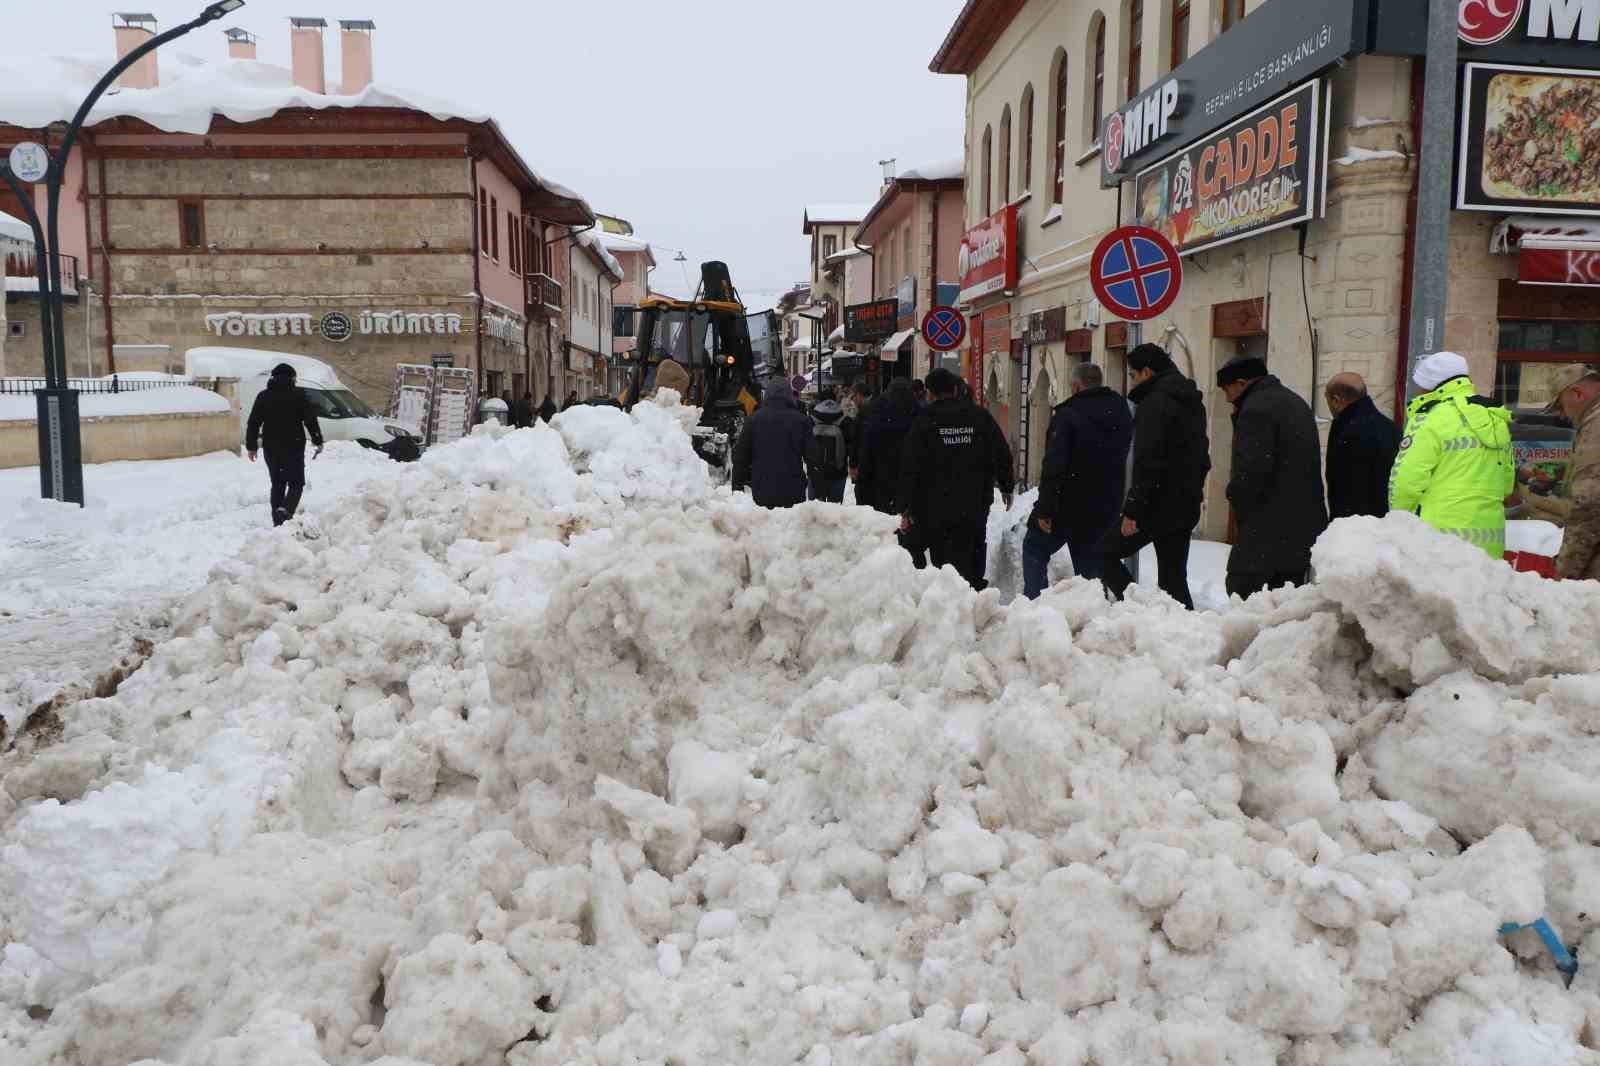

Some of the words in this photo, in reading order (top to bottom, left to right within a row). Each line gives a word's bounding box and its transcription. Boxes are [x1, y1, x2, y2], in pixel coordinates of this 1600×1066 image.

[1123, 78, 1179, 159] MHP
[1199, 102, 1298, 200] CADDE
[1206, 176, 1281, 229] KOKOREÇ
[359, 310, 462, 334] ÜRÜNLER
